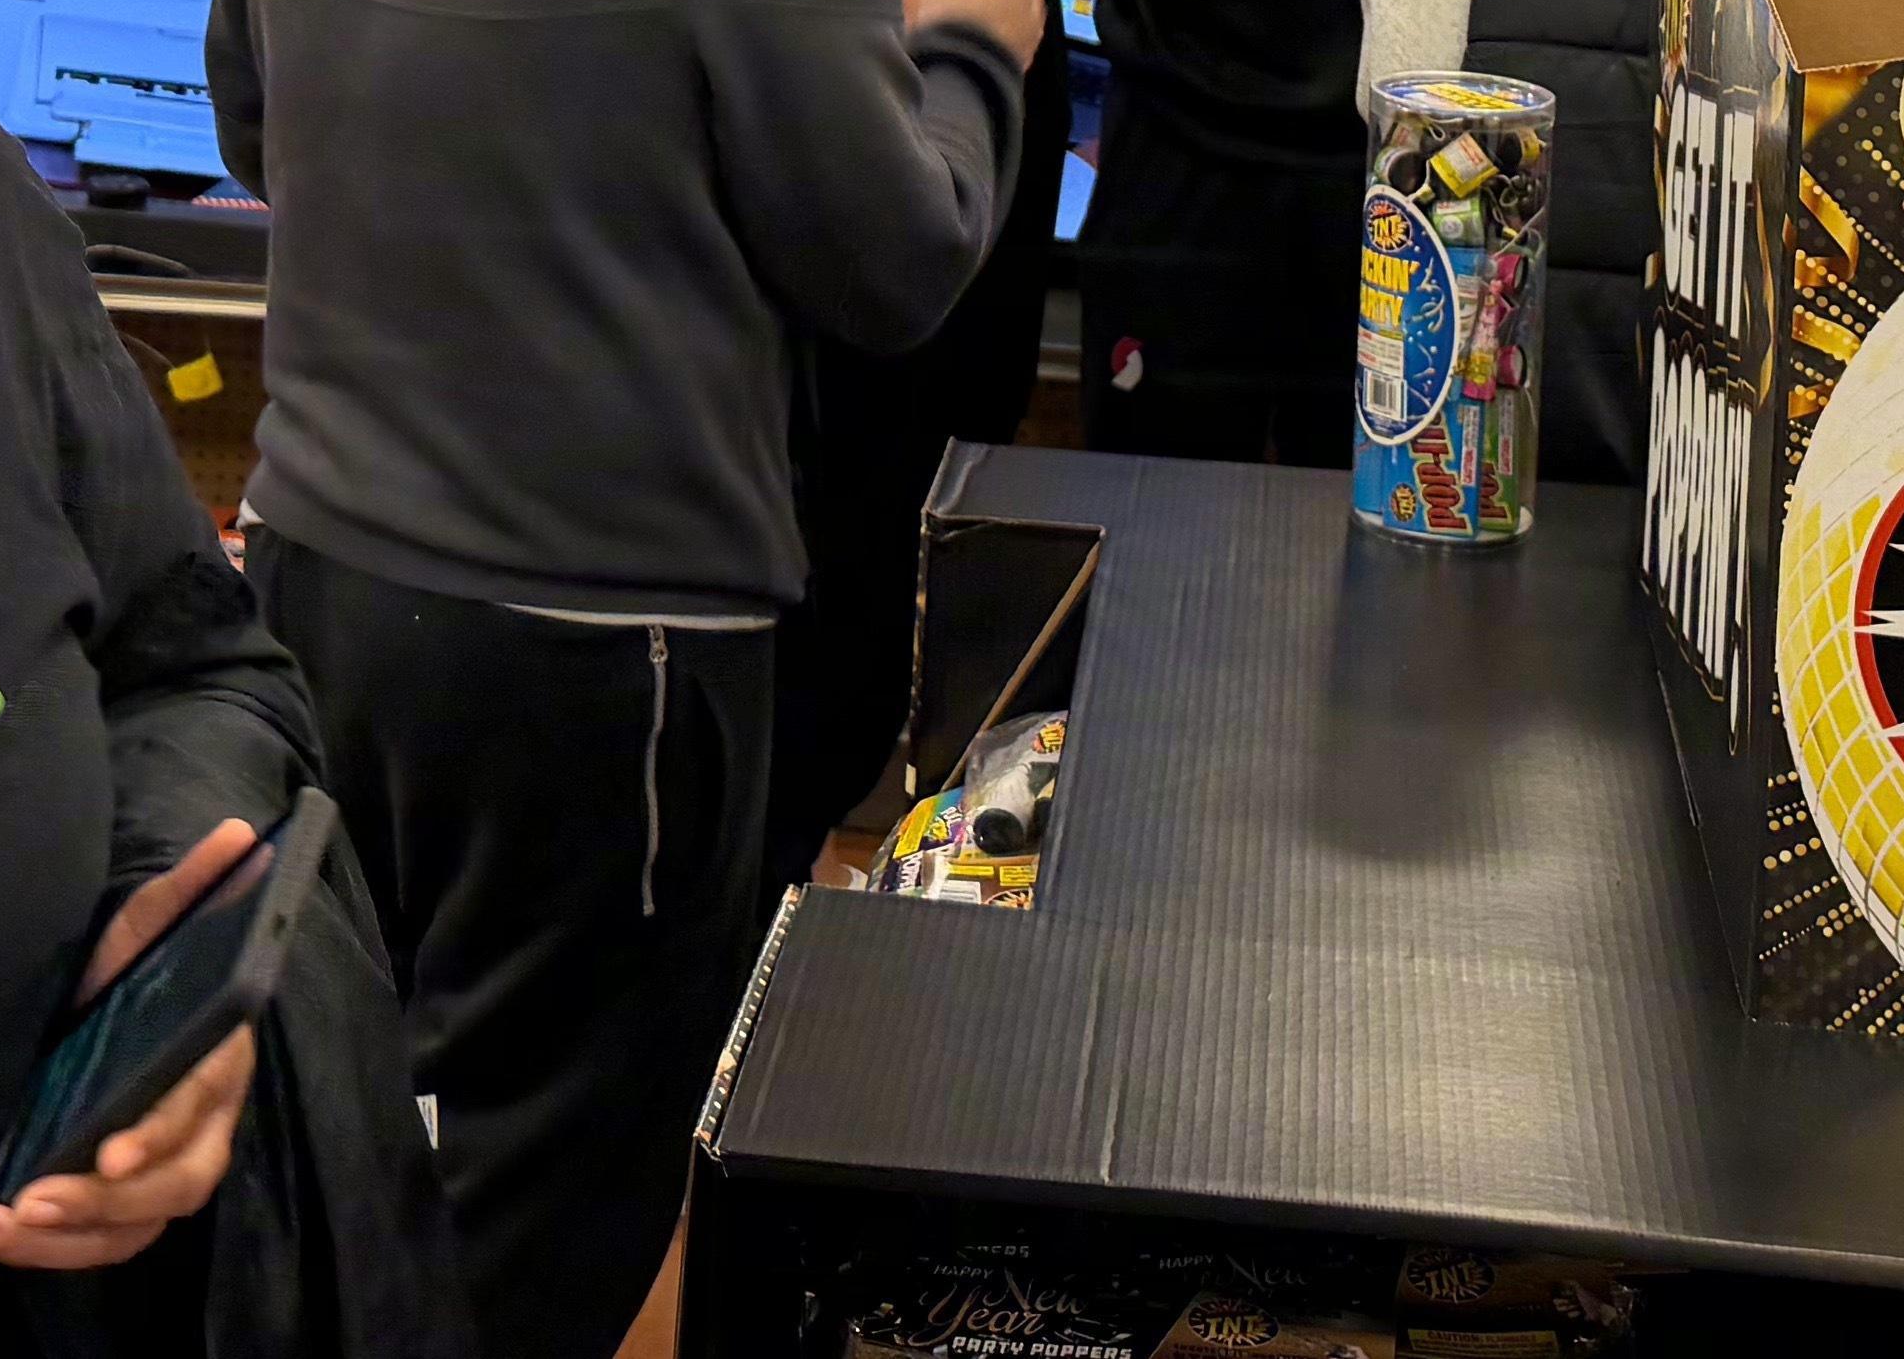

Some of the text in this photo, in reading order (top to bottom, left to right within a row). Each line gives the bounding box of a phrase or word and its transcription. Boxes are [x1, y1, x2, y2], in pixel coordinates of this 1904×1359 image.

[1665, 82, 1755, 340] GET IT
[932, 1264, 994, 1280] HAPPY
[1424, 1260, 1478, 1301] TNT
[907, 1282, 1046, 1347] Year
[1206, 1314, 1266, 1339] TNT
[952, 1335, 1133, 1359] PARTY POPPERS
